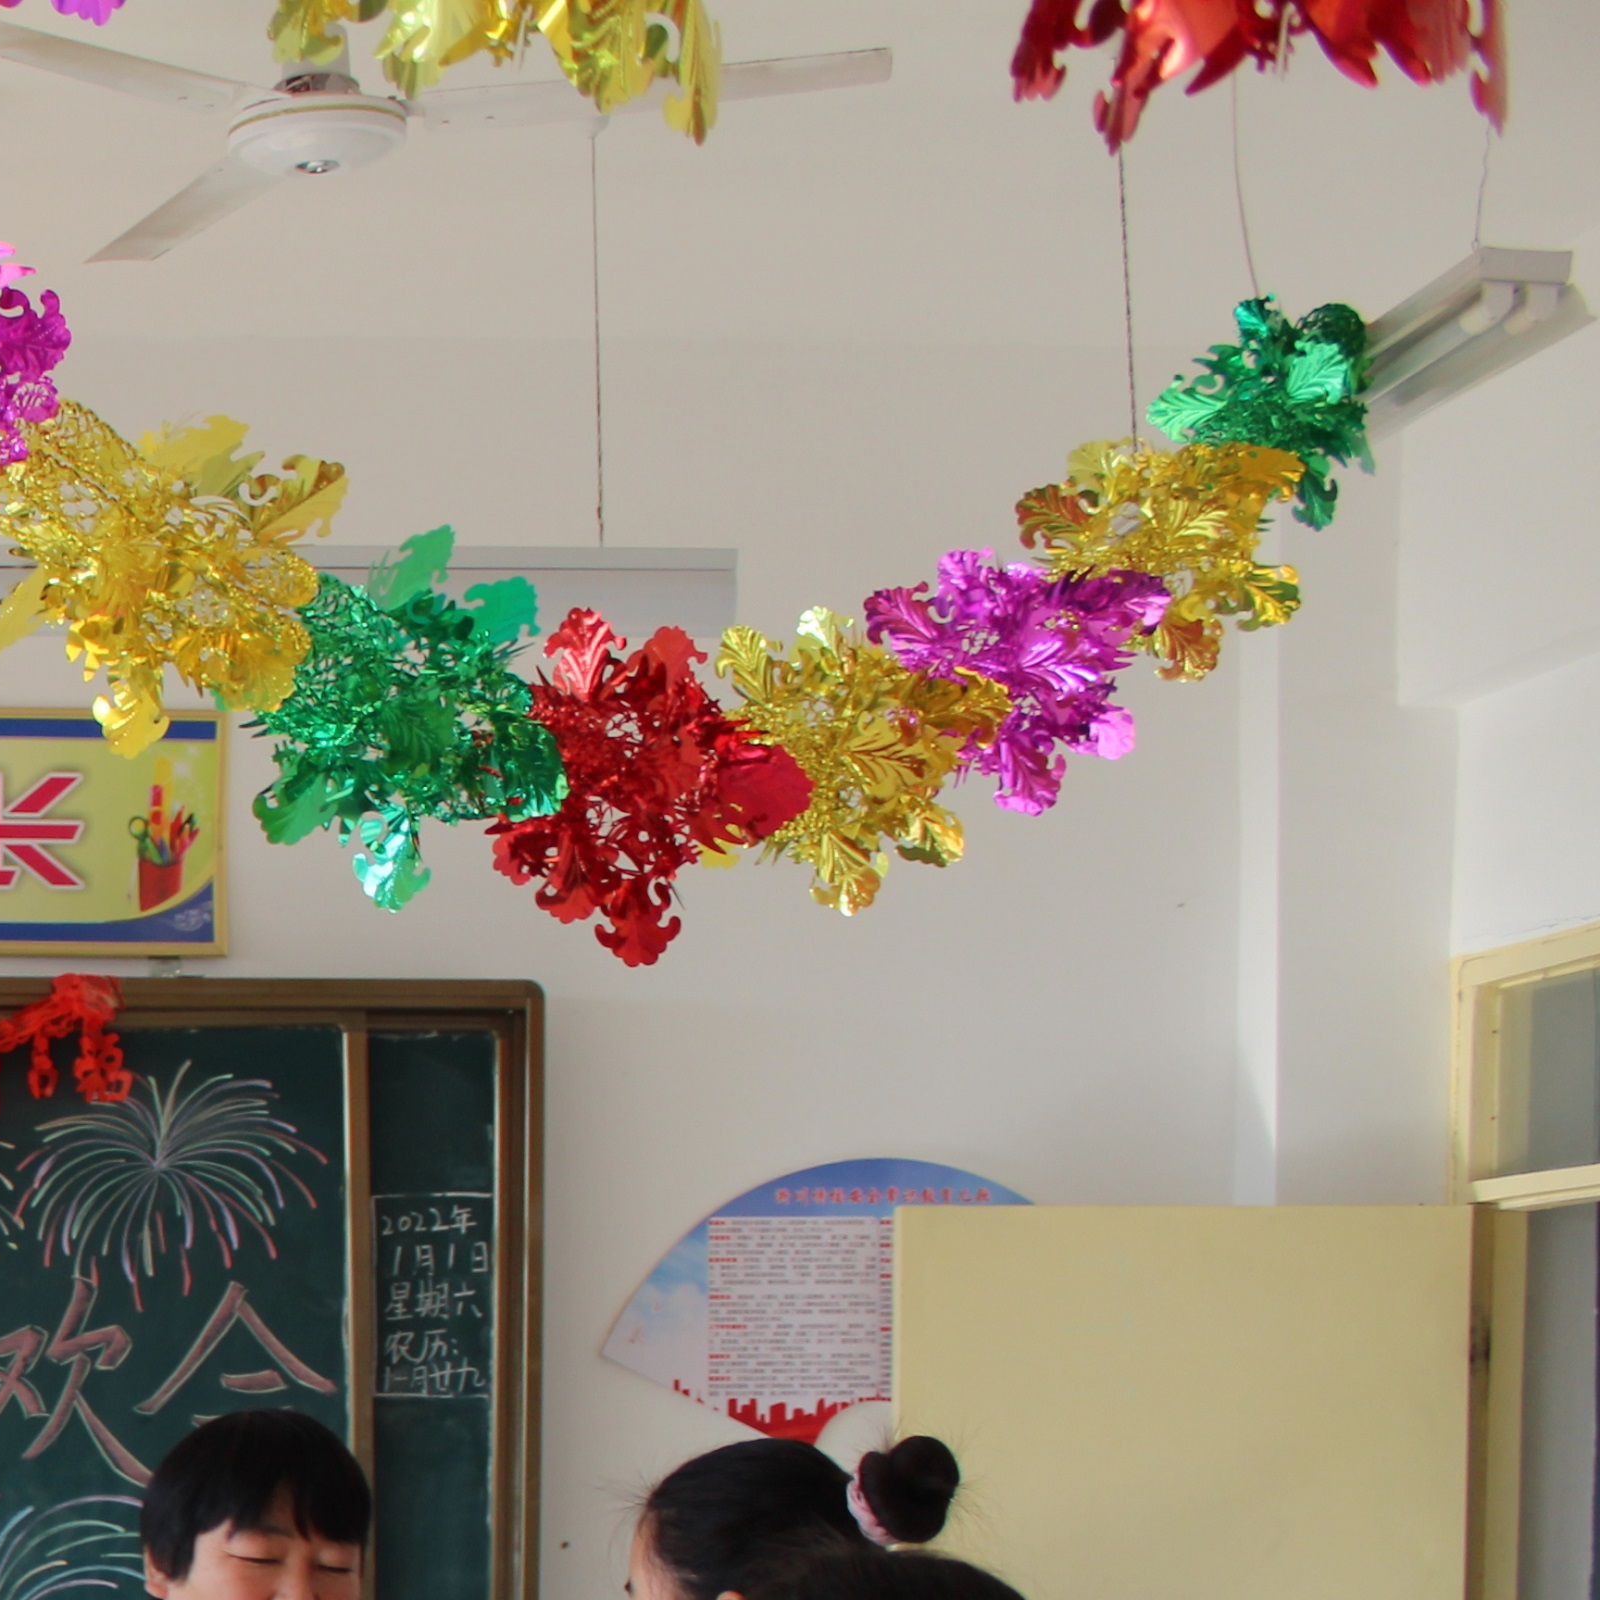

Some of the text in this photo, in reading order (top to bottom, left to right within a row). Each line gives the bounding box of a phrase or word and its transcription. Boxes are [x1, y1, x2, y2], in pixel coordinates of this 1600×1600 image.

[381, 1205, 477, 1236] 2022年
[392, 1241, 490, 1276] 1月1日
[384, 1281, 484, 1321] 星期六
